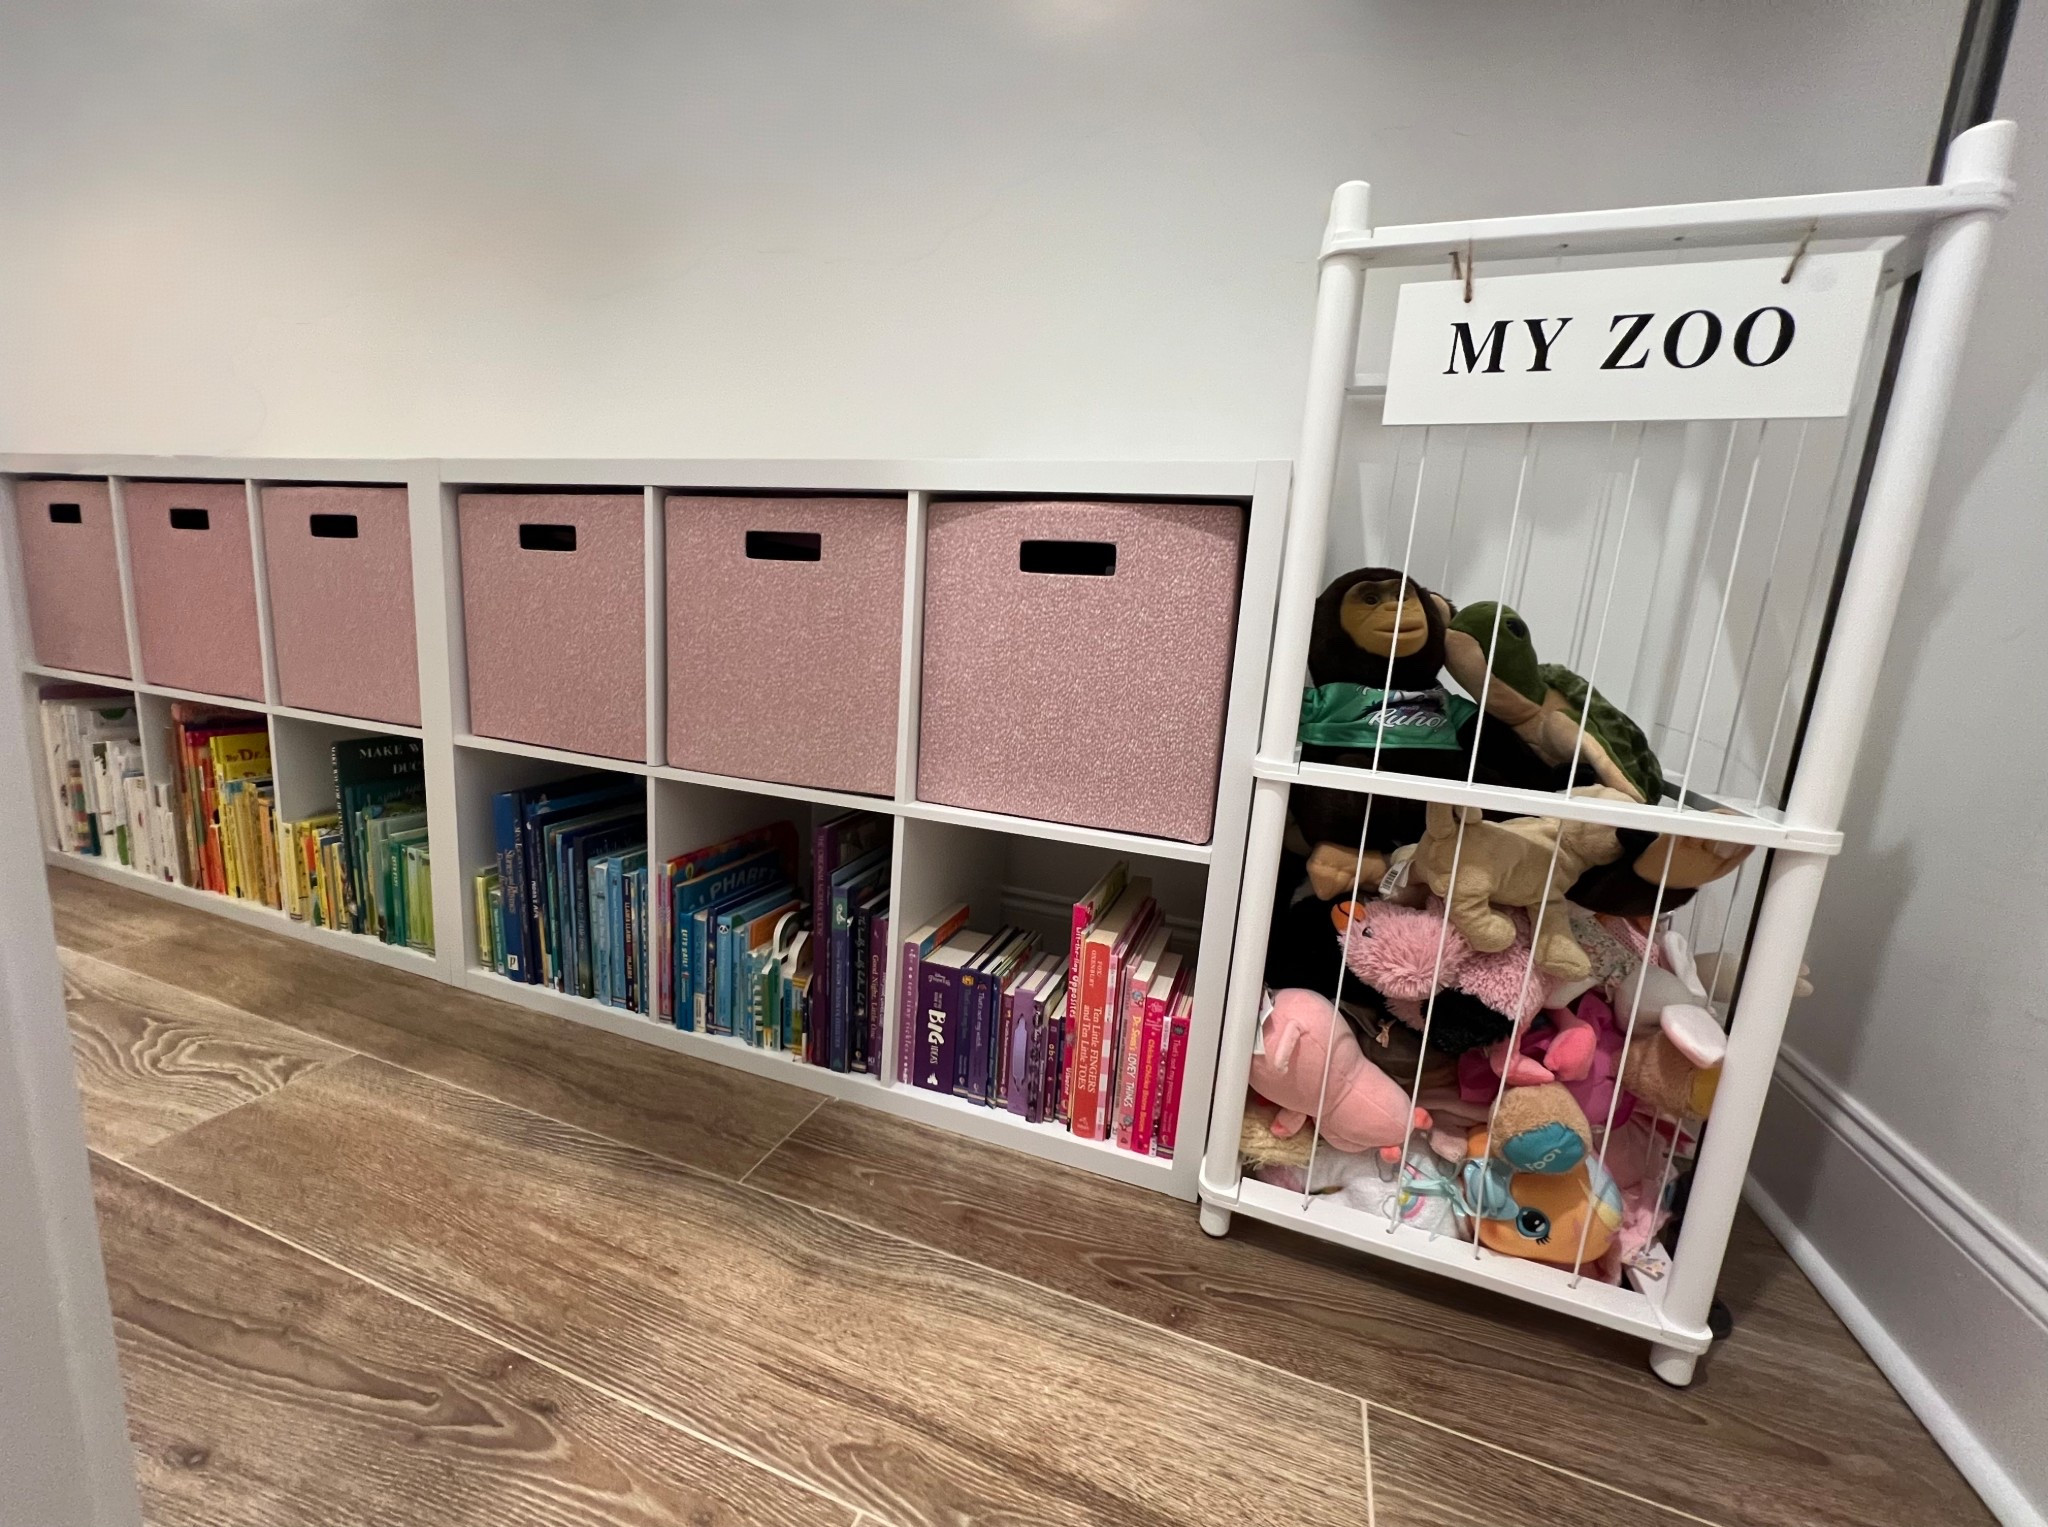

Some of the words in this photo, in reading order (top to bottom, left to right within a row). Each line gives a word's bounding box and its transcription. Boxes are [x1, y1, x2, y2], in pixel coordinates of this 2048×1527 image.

[1443, 317, 1573, 375] MY
[1599, 306, 1795, 370] ZOO
[360, 745, 403, 759] MAKE
[1089, 949, 1097, 988] OXENBURY
[1067, 975, 1080, 1019] Opposites
[870, 1002, 878, 1023] Little
[1082, 1004, 1090, 1021] and
[1093, 1007, 1102, 1023] Ten
[903, 1021, 912, 1053] tickles
[927, 1009, 947, 1045] BIG
[1081, 1023, 1090, 1038] Ten
[1091, 1025, 1101, 1048] Little
[929, 1045, 939, 1065] IDEAS
[1048, 1043, 1056, 1062] abc
[1080, 1040, 1090, 1063] Little
[1172, 1039, 1181, 1057] That's
[1077, 1064, 1087, 1090] TOES
[1088, 1049, 1099, 1094] FINGERS
[1126, 1052, 1138, 1079] LOVEY
[1166, 1071, 1176, 1081] my
[1063, 1067, 1072, 1096] Usborne
[1123, 1081, 1134, 1109] THINGS
[1141, 1089, 1149, 1111] Boom
[1138, 1111, 1147, 1133] Boom
